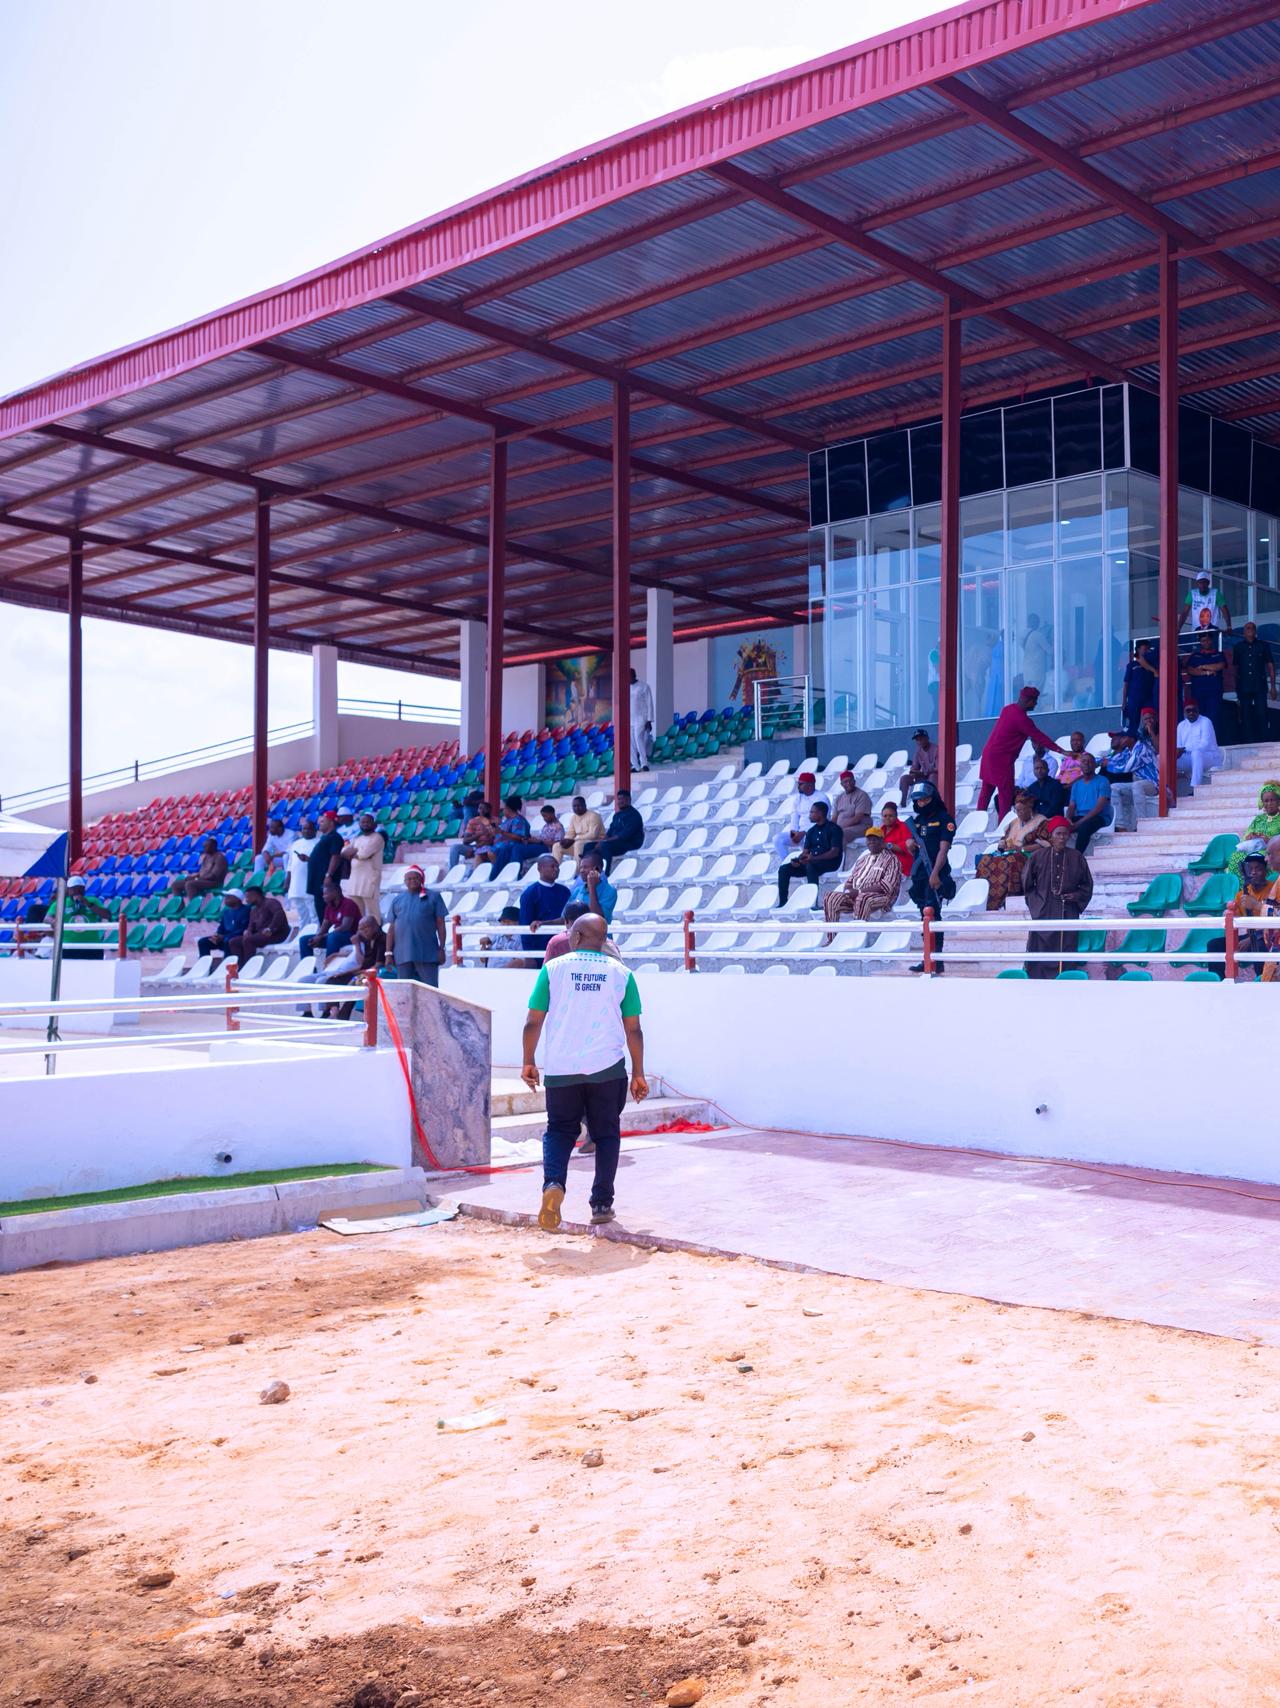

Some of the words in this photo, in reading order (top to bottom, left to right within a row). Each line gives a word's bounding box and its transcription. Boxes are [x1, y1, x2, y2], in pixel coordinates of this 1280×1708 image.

[571, 972, 582, 981] THE
[583, 973, 607, 982] FUTURE
[575, 982, 581, 991] IS
[581, 983, 602, 992] GREEN
